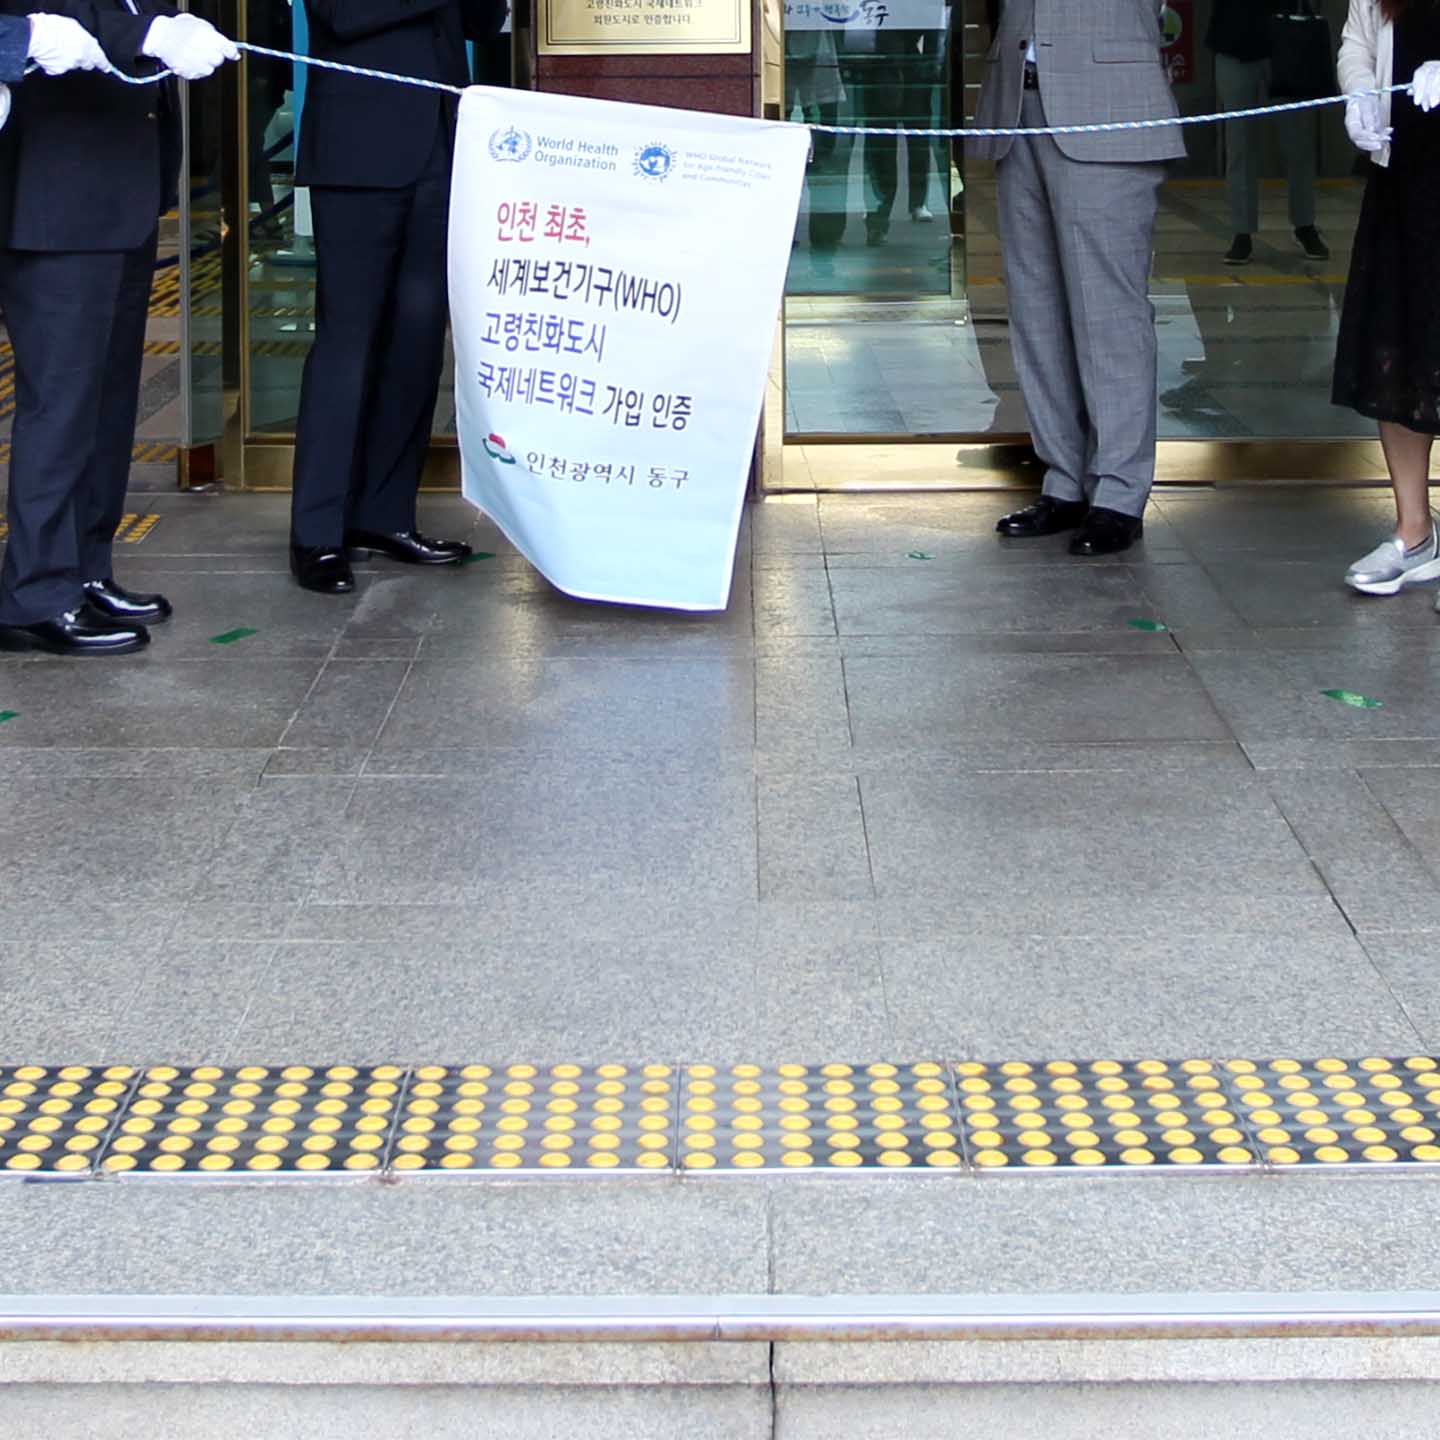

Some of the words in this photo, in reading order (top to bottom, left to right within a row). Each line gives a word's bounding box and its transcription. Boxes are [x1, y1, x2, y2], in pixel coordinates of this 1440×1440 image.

[534, 150, 618, 173] Organization
[536, 136, 573, 152] World
[578, 137, 620, 157] Health
[496, 200, 539, 243] 인천
[543, 203, 591, 248] 최초,
[486, 257, 682, 325] 세계보건기구(WHO)
[480, 311, 607, 363] 고령친화도시
[477, 360, 597, 416] 국제네트워크
[602, 384, 645, 428] 가입
[651, 393, 693, 432] 인증
[526, 450, 636, 485] 인천광역시
[647, 465, 690, 489] 동구
